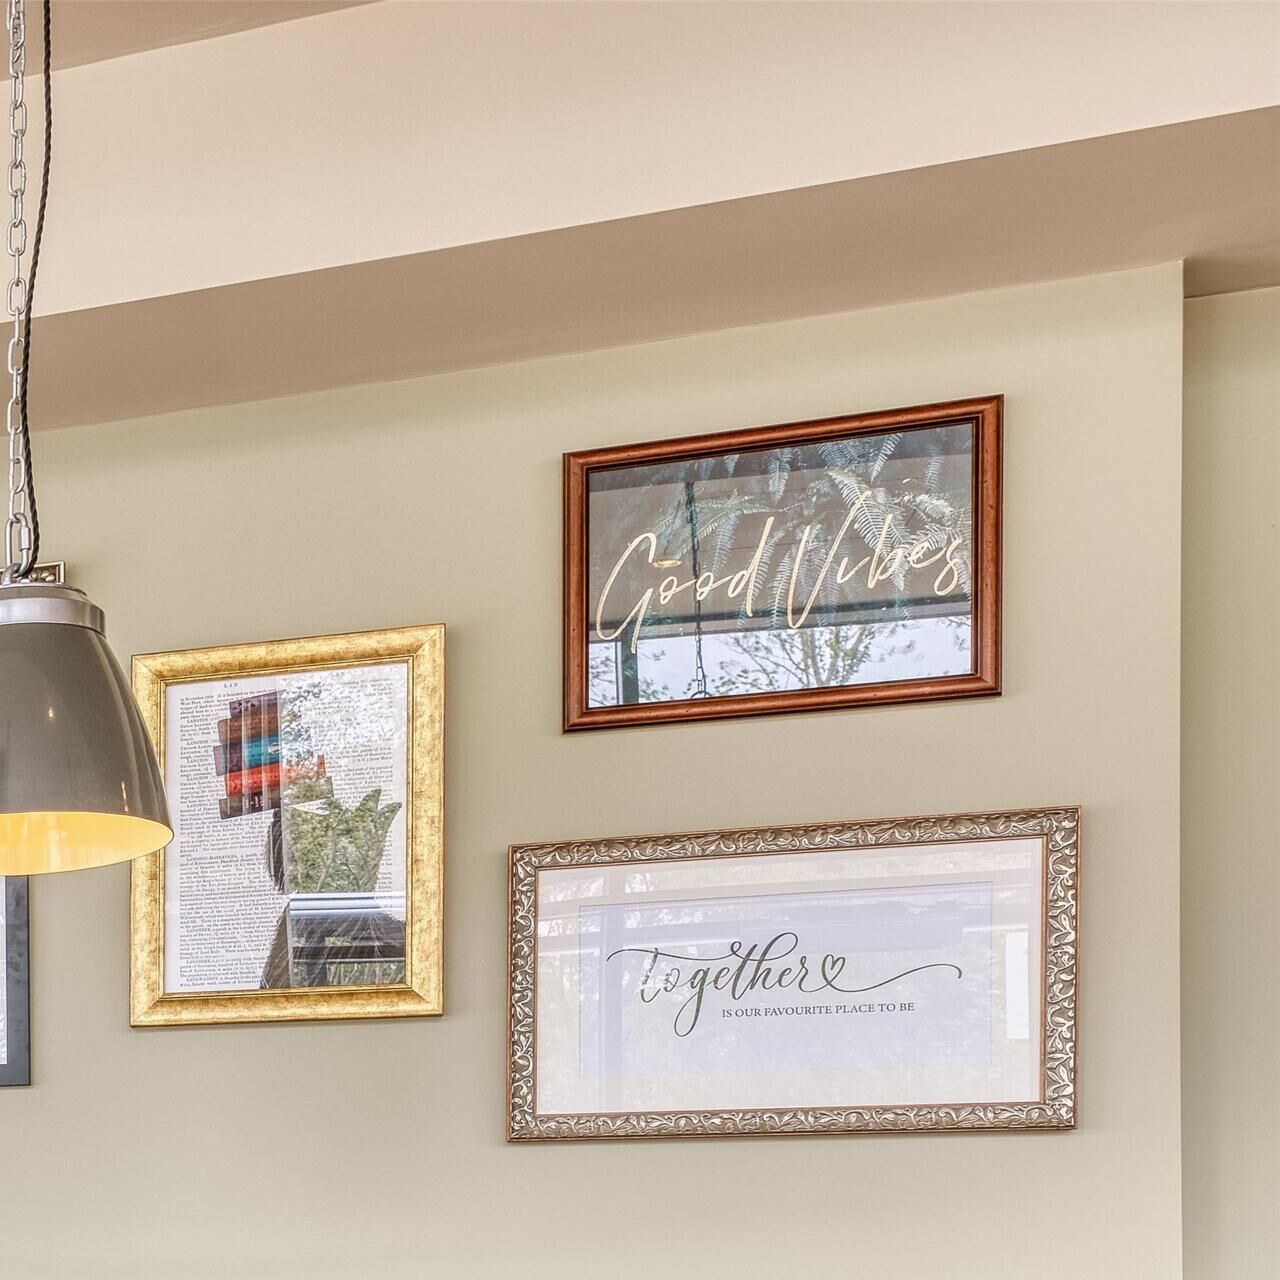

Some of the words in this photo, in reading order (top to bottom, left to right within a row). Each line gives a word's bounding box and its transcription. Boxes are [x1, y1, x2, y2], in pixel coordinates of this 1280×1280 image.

[596, 516, 775, 655] Good
[786, 489, 964, 630] Vibes
[722, 1009, 732, 1018] IS
[735, 1008, 762, 1017] OUR
[764, 1005, 833, 1016] FAVOURITE
[835, 1003, 875, 1014] PLACE
[878, 1003, 897, 1012] TO
[899, 1002, 915, 1012] BE
